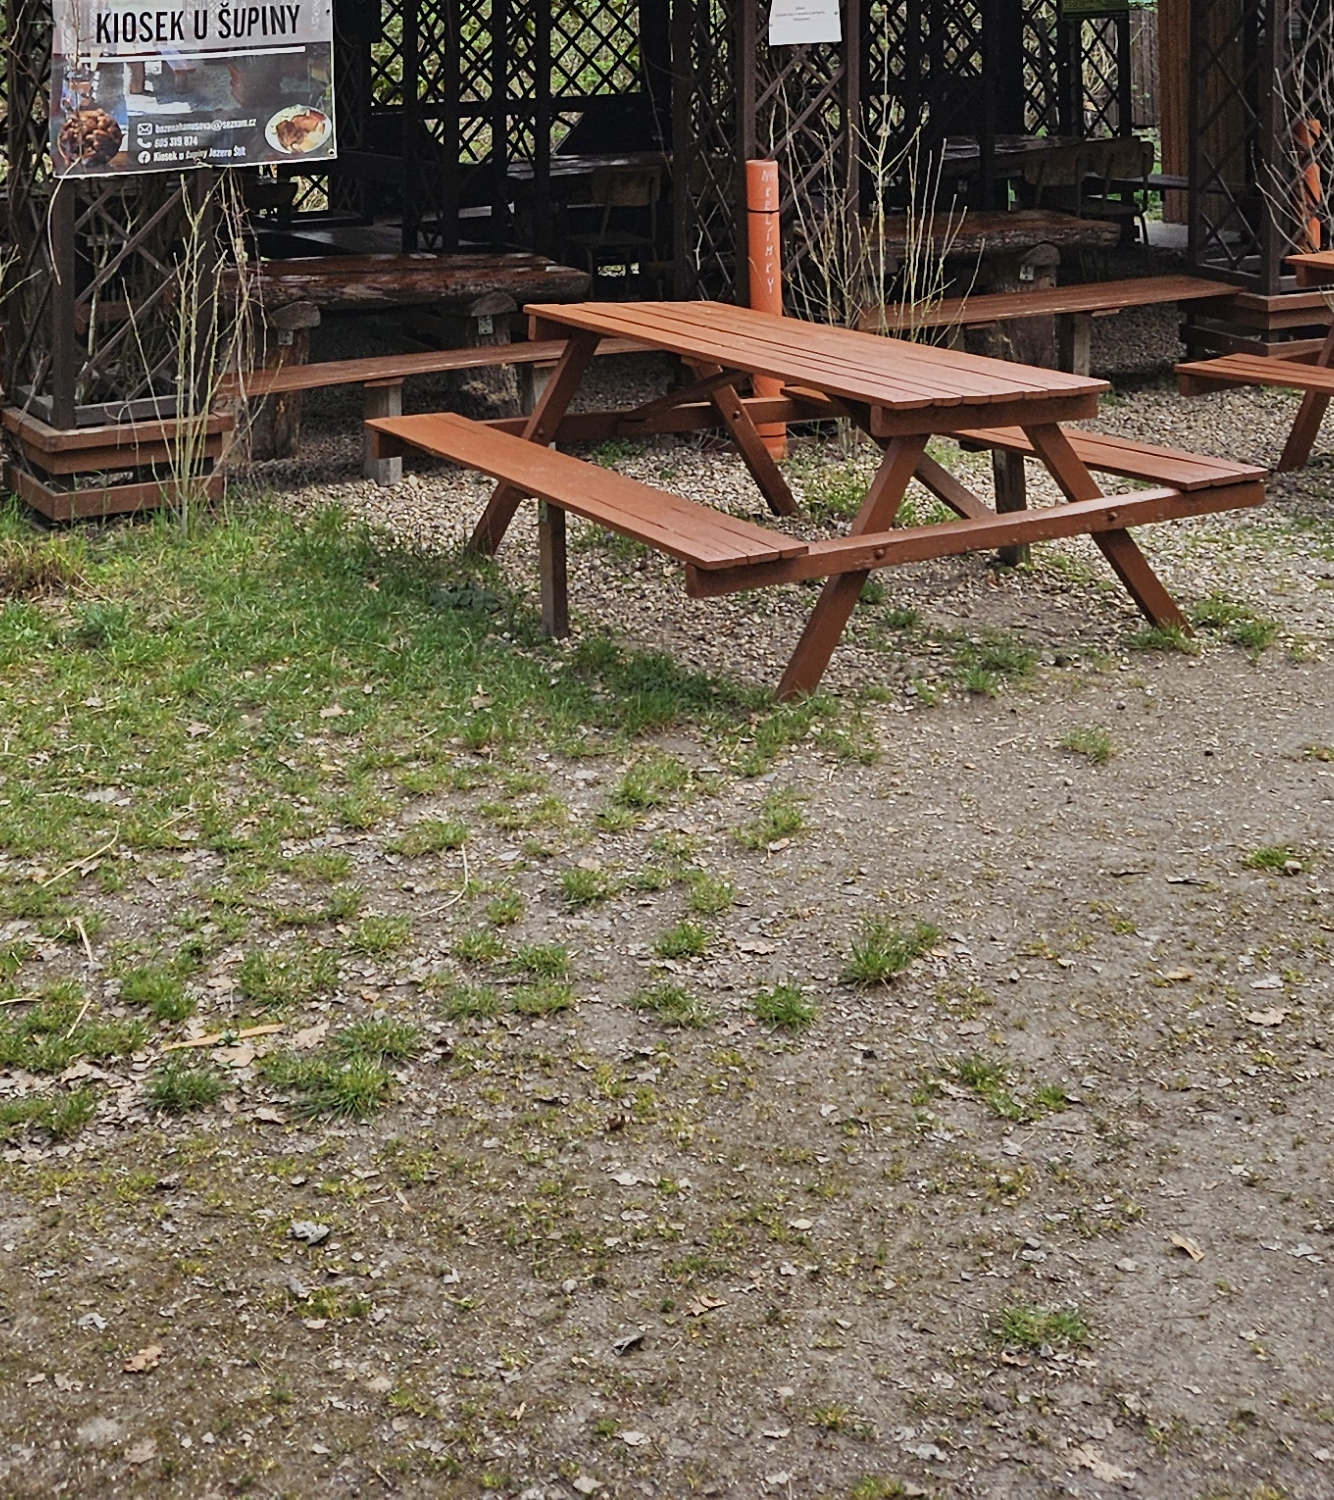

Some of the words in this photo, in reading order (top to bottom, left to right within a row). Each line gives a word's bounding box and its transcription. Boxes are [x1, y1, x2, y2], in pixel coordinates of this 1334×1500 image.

[96, 10, 186, 44] KIOSEK
[194, 9, 208, 40] U
[218, 2, 301, 40] ŠUPINY
[153, 151, 178, 162] Kiosek
